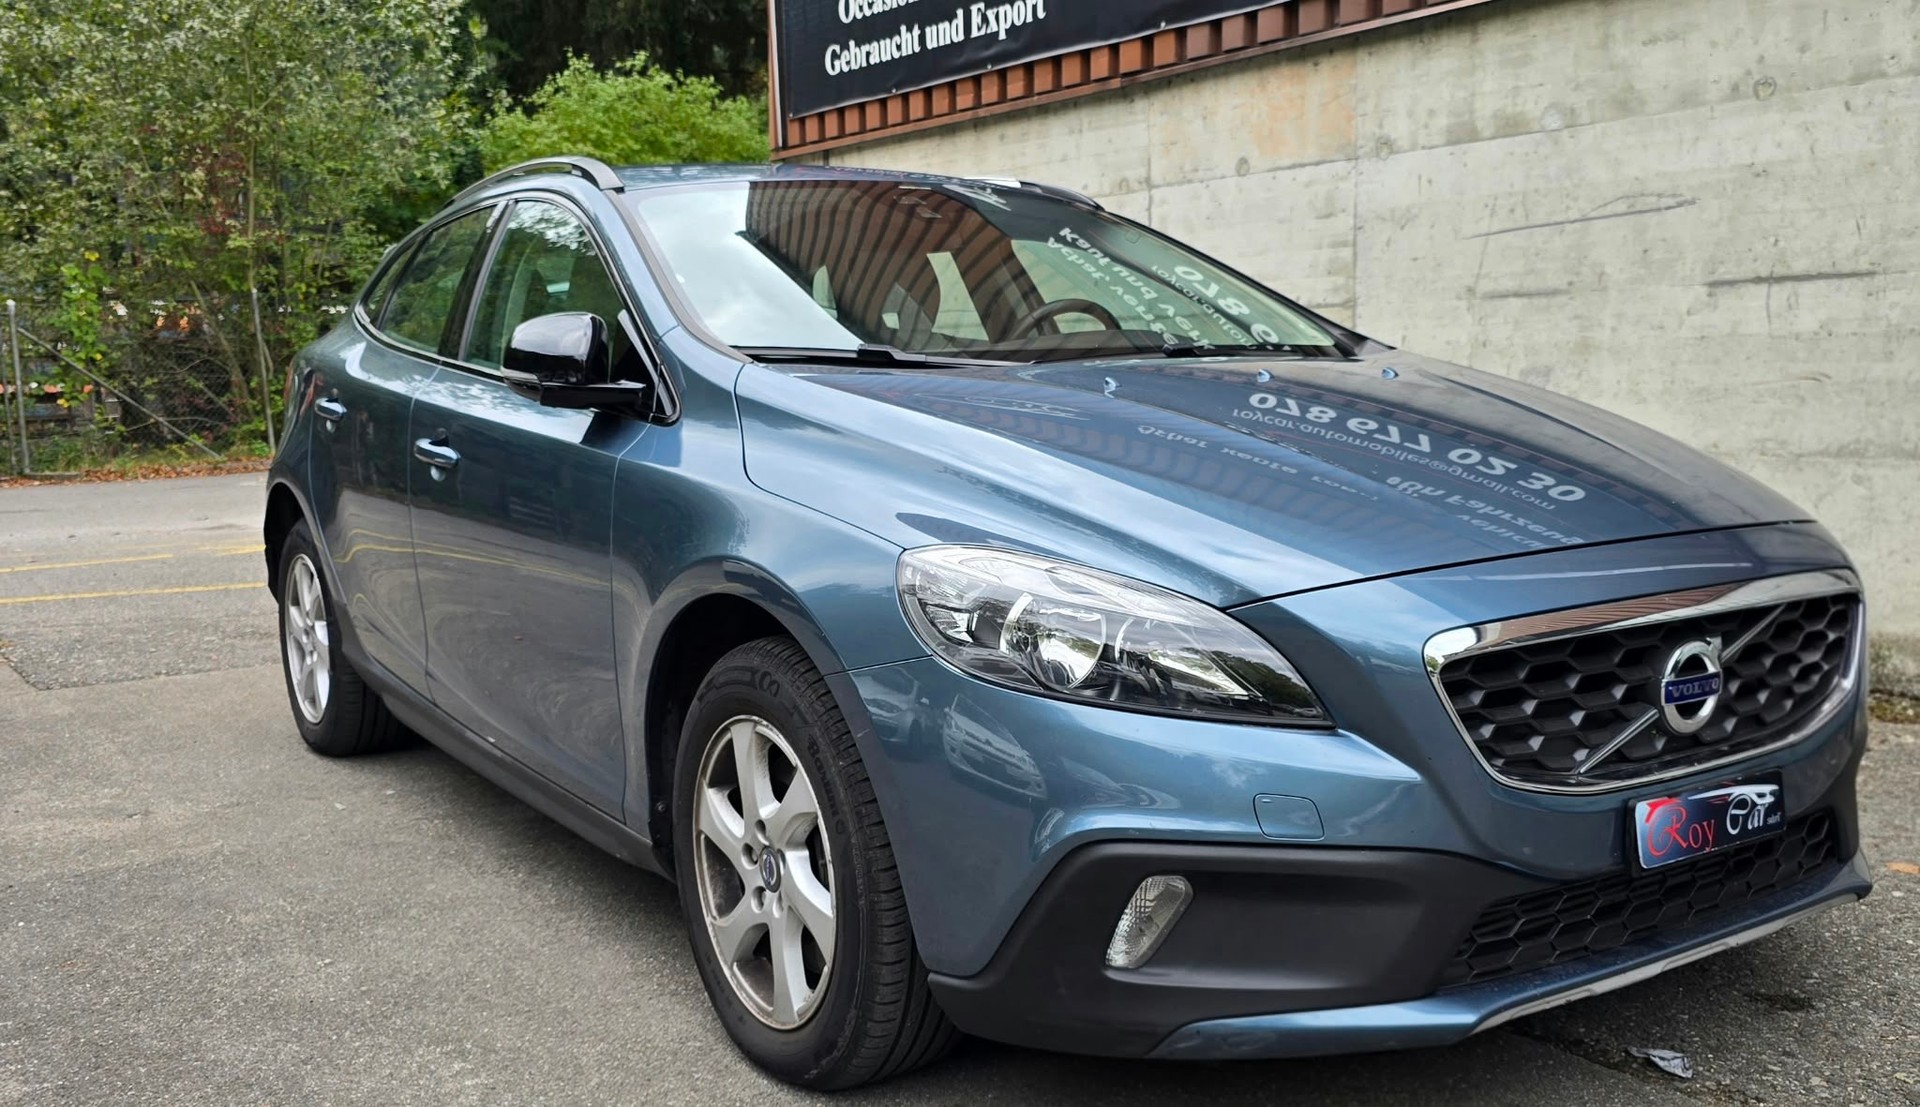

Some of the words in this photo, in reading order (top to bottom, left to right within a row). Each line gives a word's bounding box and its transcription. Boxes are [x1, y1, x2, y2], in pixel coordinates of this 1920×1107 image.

[825, 25, 922, 76] Gebraucht
[925, 8, 965, 49] und
[970, 0, 1046, 40] Export
[1669, 677, 1719, 698] VOLVO
[1647, 803, 1716, 857] Roy
[1727, 793, 1768, 835] Car
